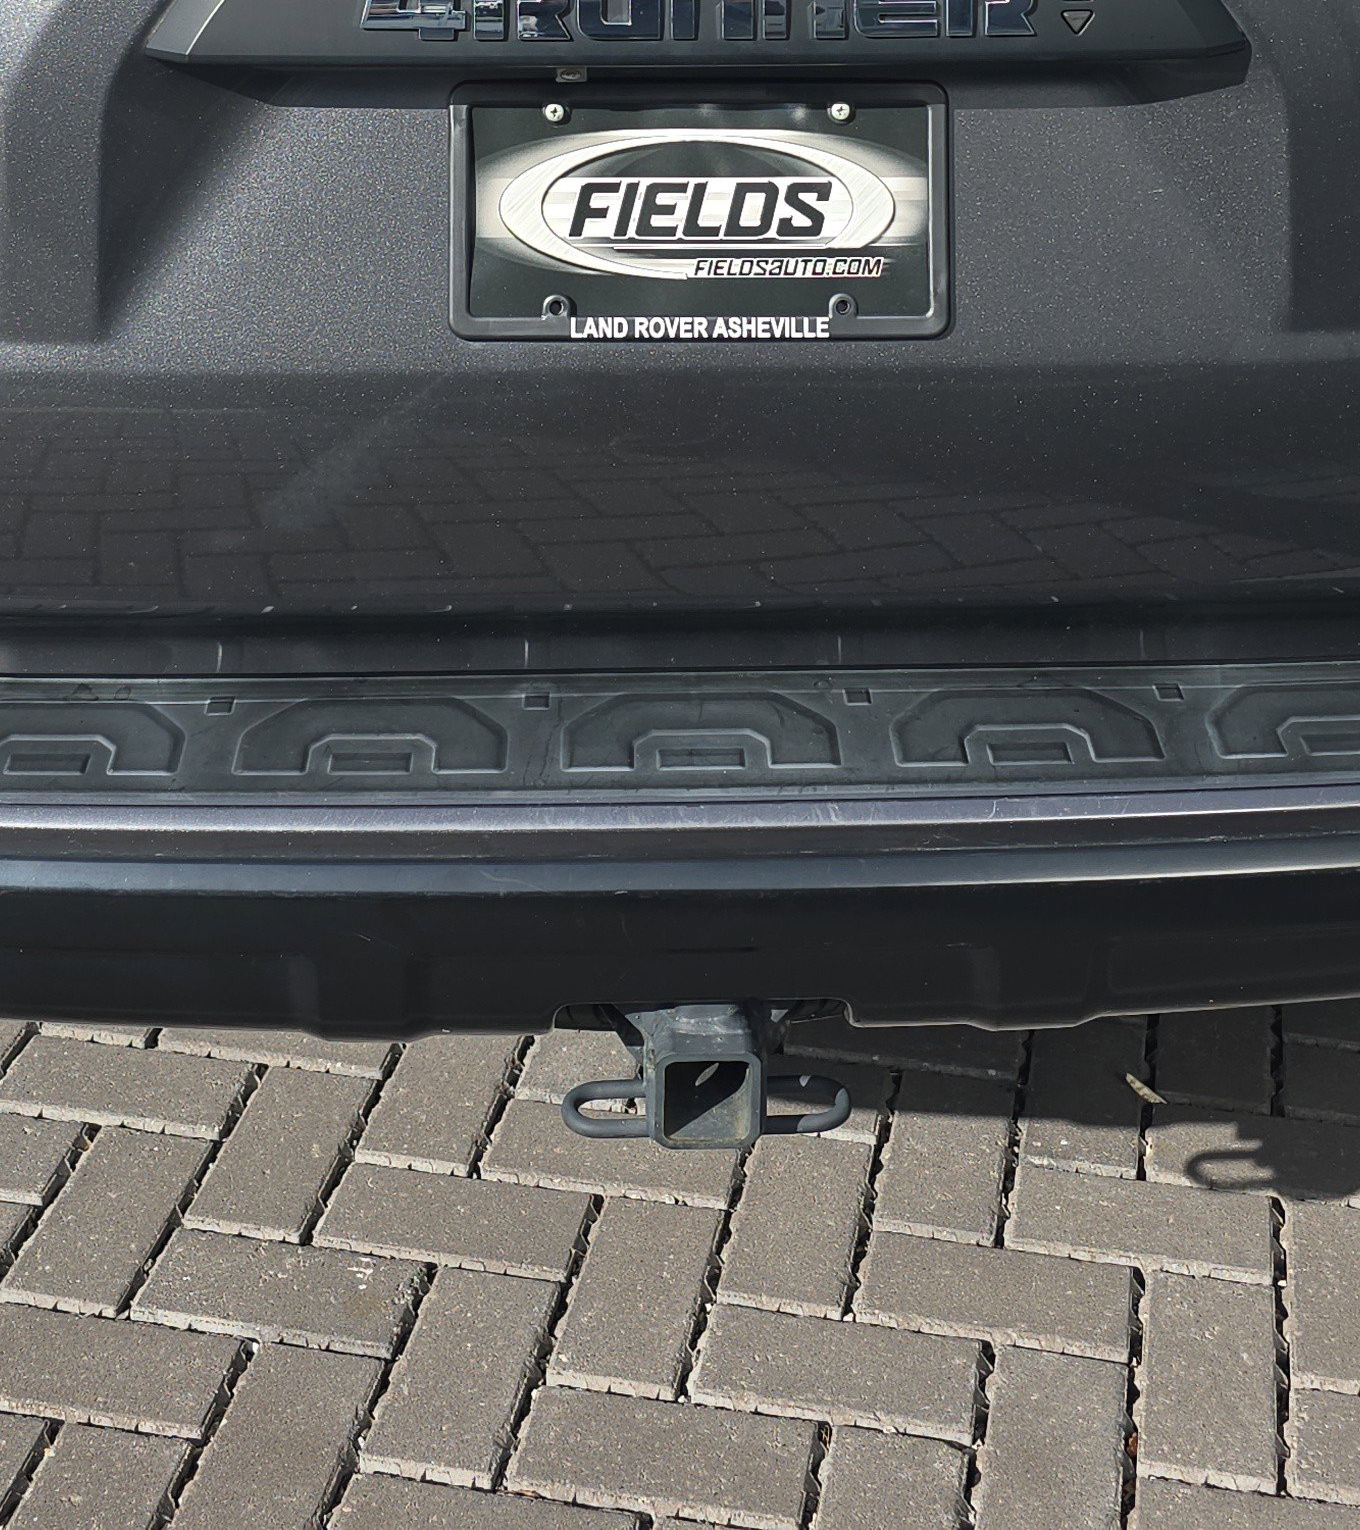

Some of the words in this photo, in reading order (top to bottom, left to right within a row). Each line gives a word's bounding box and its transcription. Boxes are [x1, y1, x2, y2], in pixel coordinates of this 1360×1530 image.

[568, 180, 833, 238] FIELDS
[570, 317, 628, 339] LAND
[634, 317, 709, 339] ROVER
[712, 317, 830, 339] ASHEVILLE
